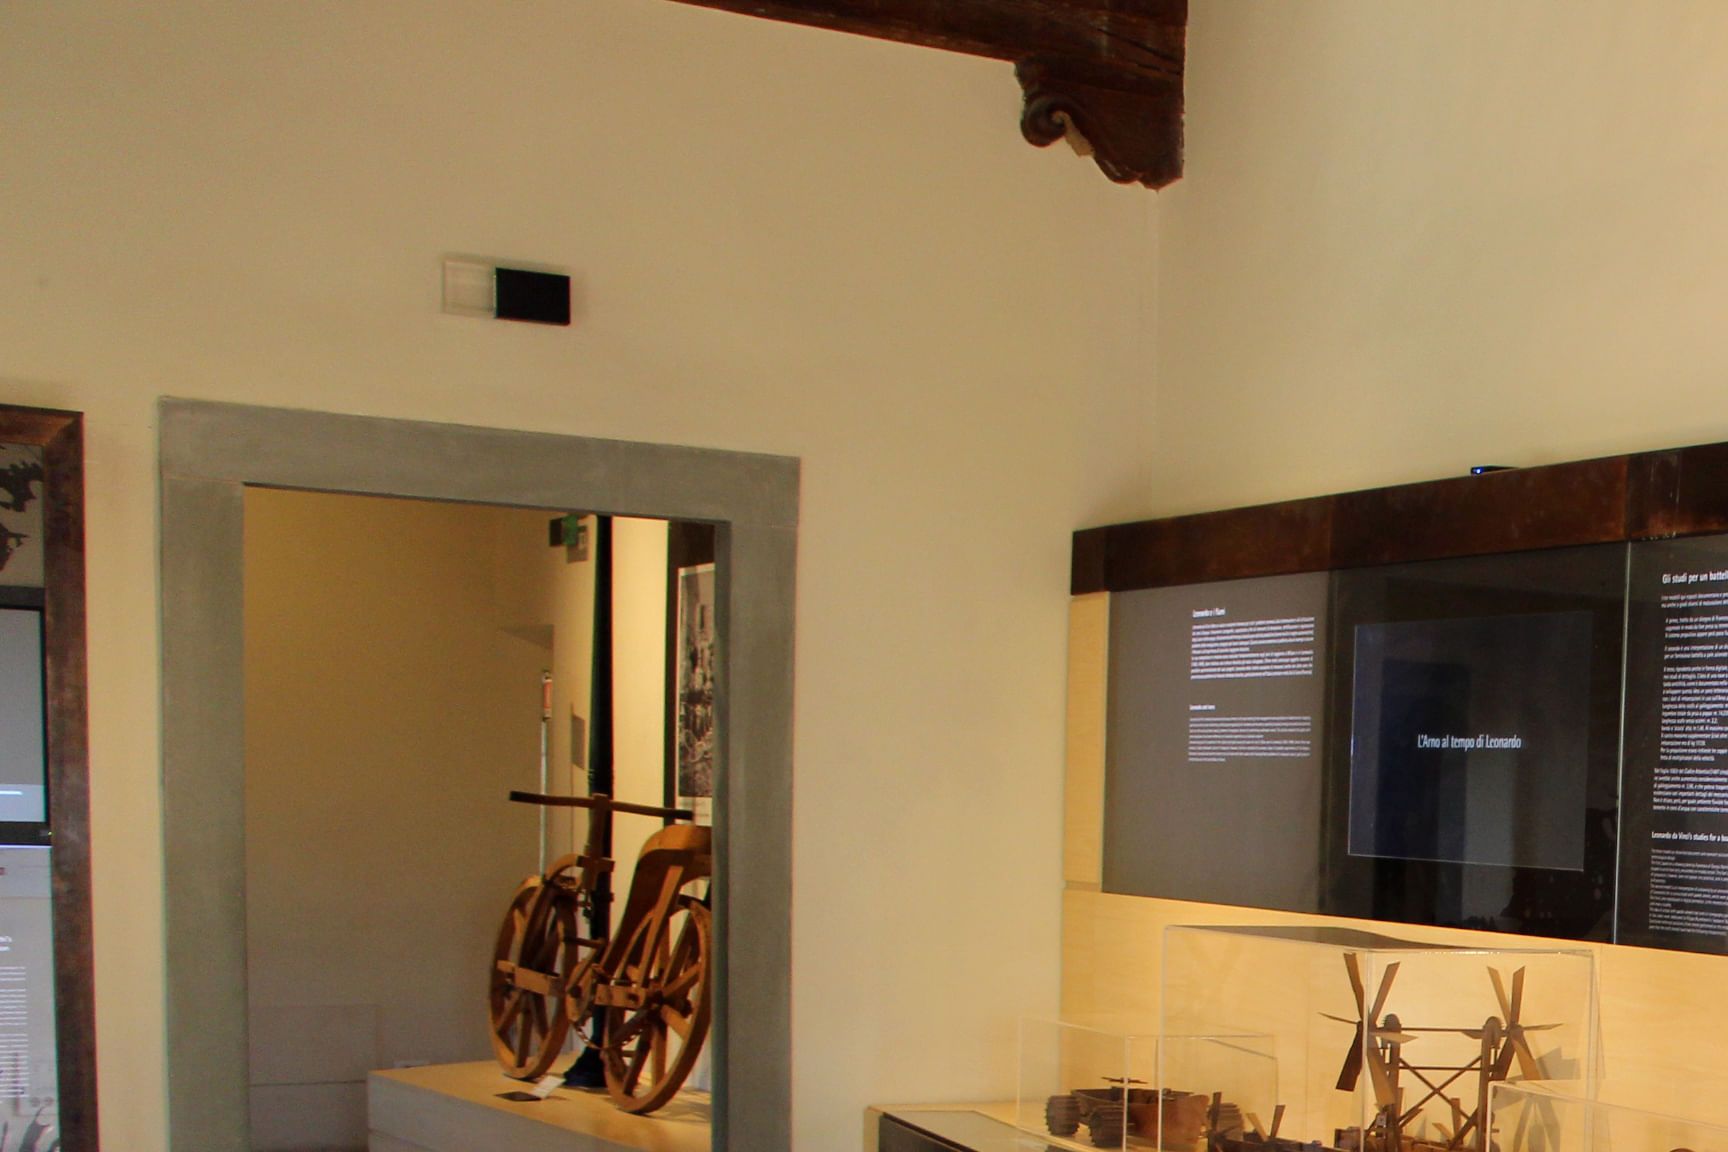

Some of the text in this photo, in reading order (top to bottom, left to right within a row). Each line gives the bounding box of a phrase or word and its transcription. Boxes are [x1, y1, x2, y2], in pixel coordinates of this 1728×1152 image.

[1662, 574, 1671, 584] Gli
[1672, 572, 1688, 583] studi
[1688, 574, 1698, 584] per
[1700, 574, 1708, 582] un
[1417, 734, 1522, 752] L'Arno al tempo di Leonardo
